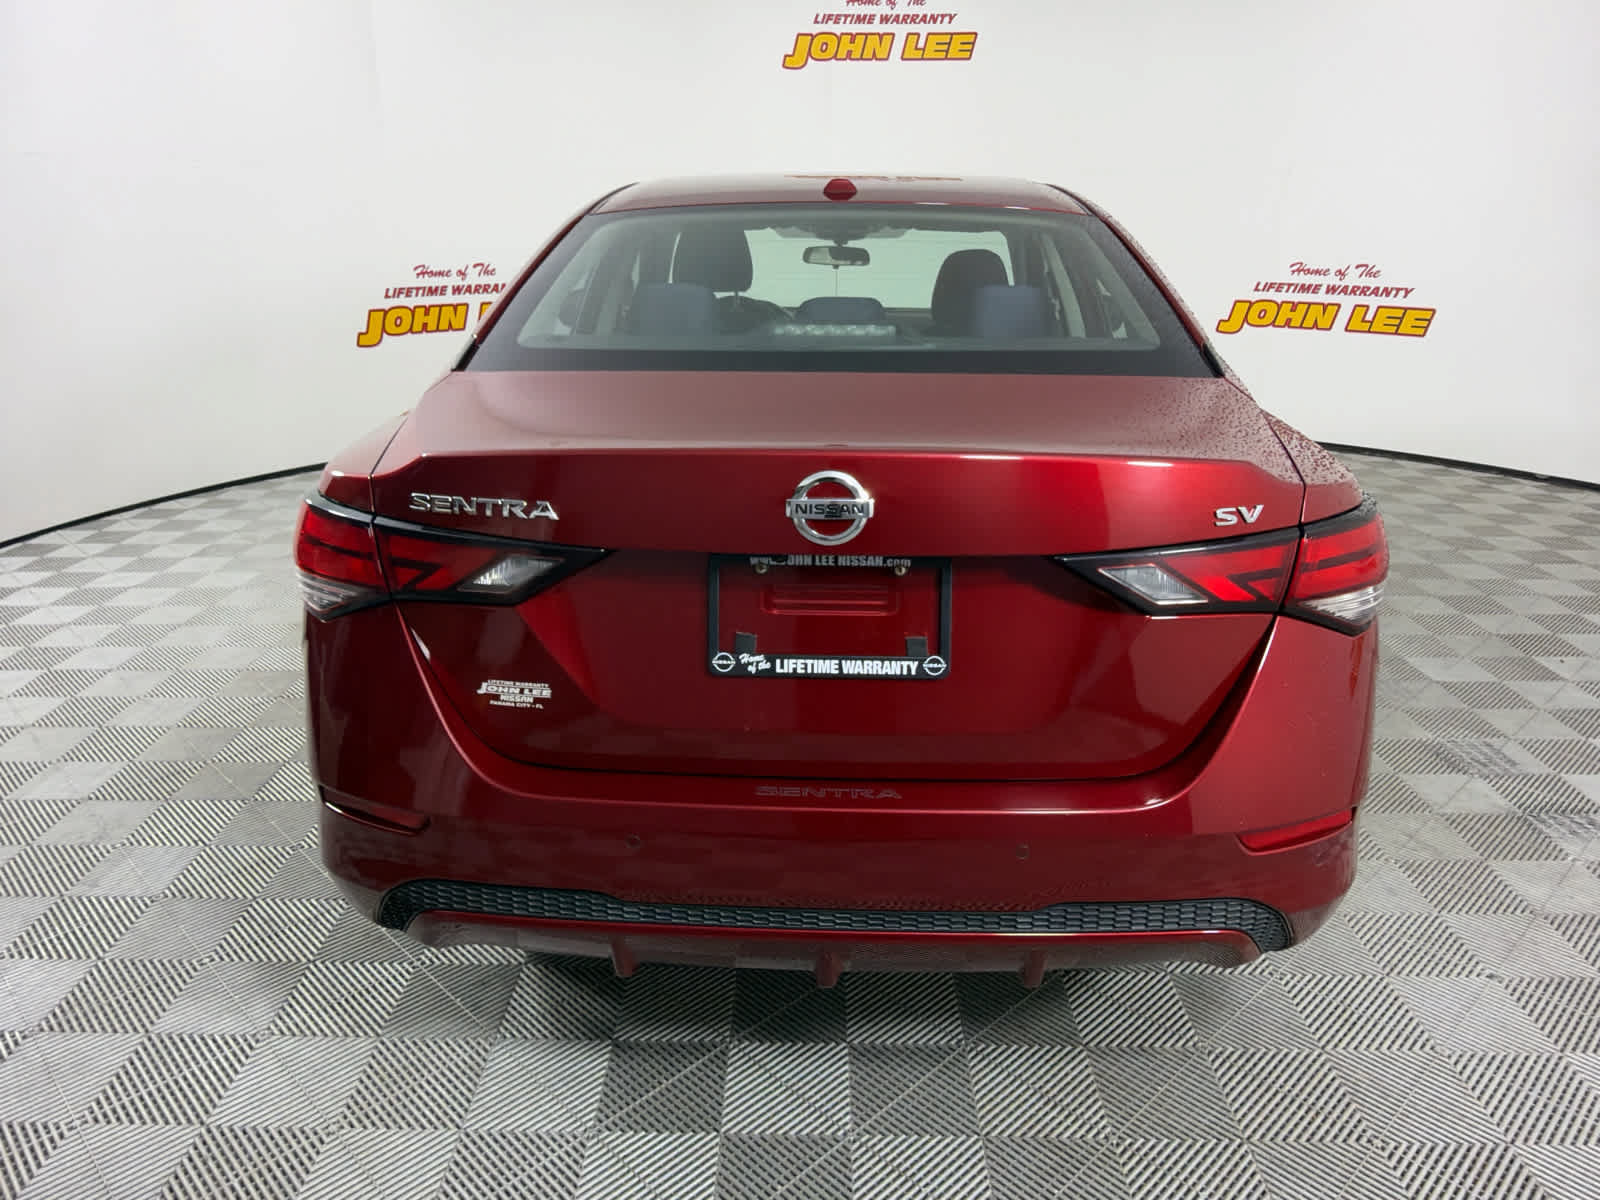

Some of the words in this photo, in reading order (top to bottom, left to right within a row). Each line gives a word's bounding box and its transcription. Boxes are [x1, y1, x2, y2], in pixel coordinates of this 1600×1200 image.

[813, 13, 876, 25] LIFETIME
[879, 13, 957, 25] WARRANTY
[782, 32, 895, 70] JOHN
[900, 32, 978, 61] LEE
[413, 264, 452, 279] Home
[456, 264, 469, 281] of
[472, 262, 496, 277] The
[1289, 261, 1331, 277] Home
[1334, 264, 1351, 280] of
[1355, 263, 1382, 279] The
[384, 284, 448, 299] LIFETIME
[1253, 281, 1322, 295] LIFETIME
[1324, 284, 1415, 299] WARRANTY
[356, 303, 469, 348] JOHN
[1216, 299, 1341, 334] JOHN
[1345, 304, 1436, 337] LEE
[409, 492, 560, 521] SENTRA
[795, 503, 865, 516] NISSAN
[1214, 504, 1265, 527] SV
[815, 554, 836, 567] LEE
[776, 659, 839, 674] LIFETIME
[842, 660, 918, 676] WARRANTY
[476, 682, 520, 695] JOHN
[523, 688, 552, 698] LEE
[754, 785, 903, 800] SENTRA
